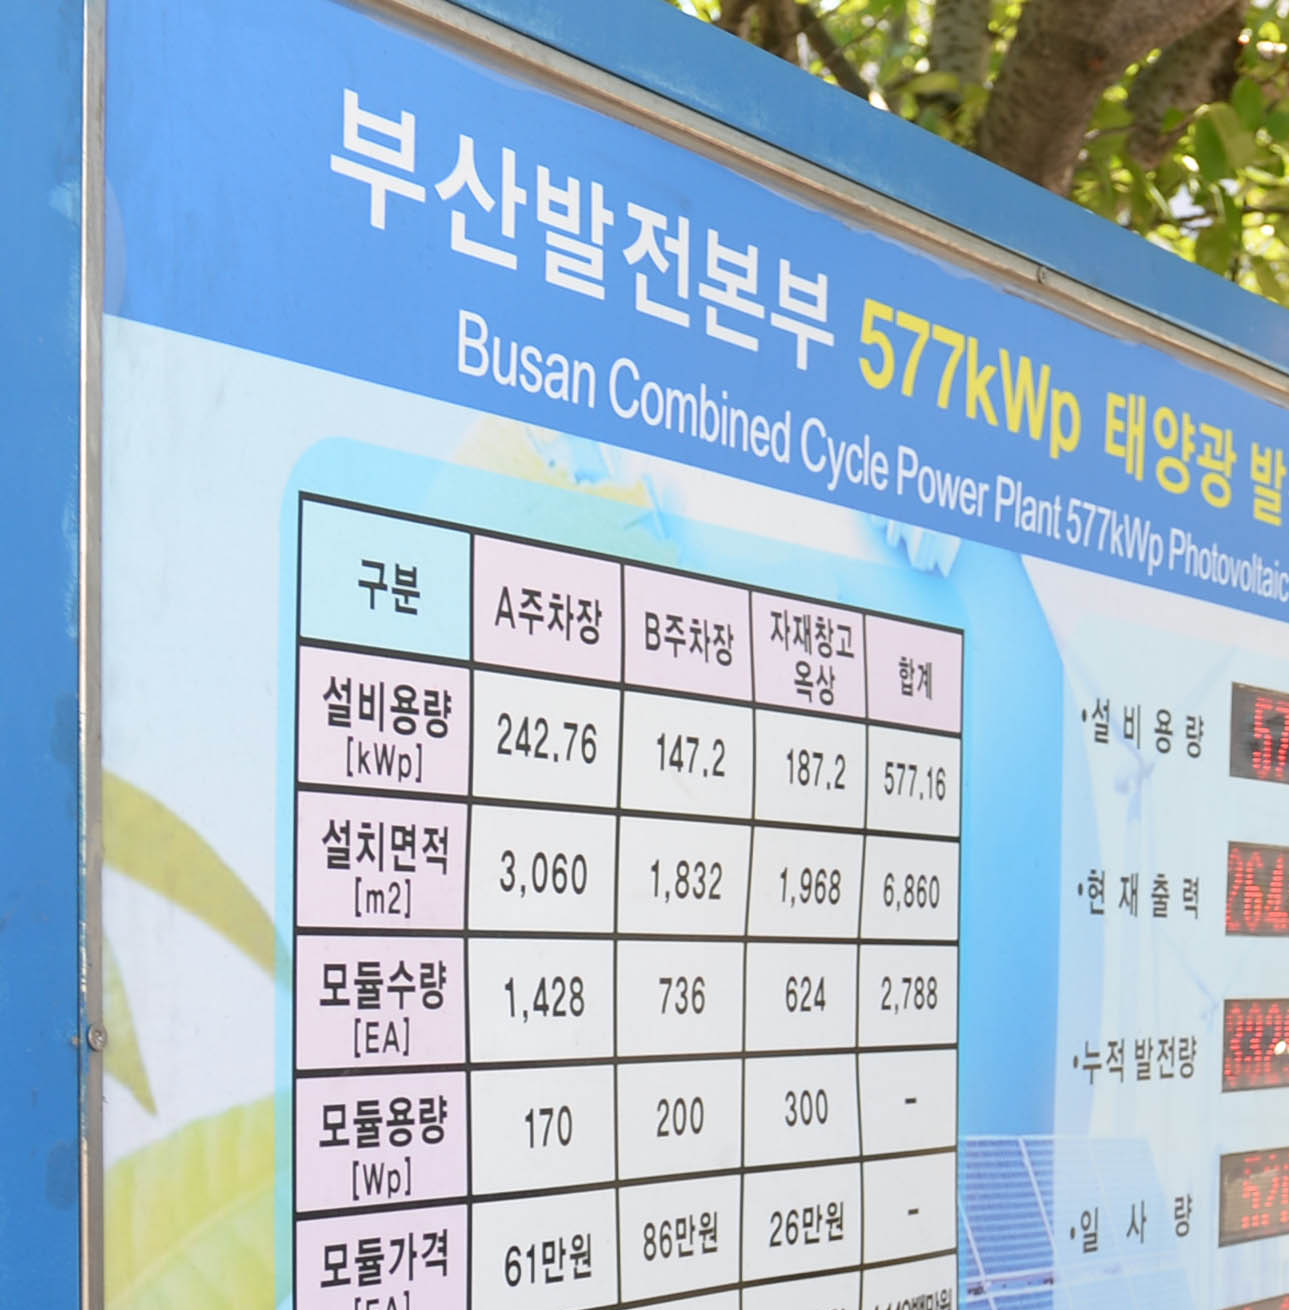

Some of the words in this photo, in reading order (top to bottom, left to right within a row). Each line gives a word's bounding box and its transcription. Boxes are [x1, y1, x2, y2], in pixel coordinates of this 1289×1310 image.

[330, 88, 835, 370] 부산발전본부
[857, 297, 1081, 458] 577kWp
[1104, 393, 1236, 508] 태양광
[458, 309, 596, 409] Busan
[608, 357, 791, 464] Combined
[800, 415, 889, 492] Cycle
[897, 445, 989, 518] Power
[995, 475, 1062, 541] Plant
[1066, 497, 1164, 577] 577kWp
[1169, 525, 1289, 603] Photovoltaic
[358, 559, 420, 616] 구분
[495, 586, 602, 645] A주차장
[645, 611, 734, 666] B주차장
[770, 609, 855, 660] 자재창고
[794, 661, 836, 706] 옥상
[898, 656, 933, 700] 합계
[322, 675, 452, 739] 설비용량
[347, 735, 423, 784] [kWp]
[497, 712, 598, 764] 242.76
[656, 732, 726, 778] 147.2
[787, 747, 846, 790] 187.2
[884, 761, 946, 801] 577.16
[321, 819, 449, 875] 설치면적
[354, 876, 412, 919] [m2]
[500, 850, 588, 898] 3,060
[650, 859, 723, 903] 1,832
[780, 866, 842, 908] 1,968
[883, 872, 941, 912] 6,860
[319, 959, 447, 1011] 모듈수량
[504, 975, 585, 1023] 1,428
[659, 976, 706, 1015] 736
[785, 976, 827, 1013] 624
[881, 976, 938, 1015] 2,788
[353, 1016, 410, 1059] [EA]
[319, 1095, 448, 1149] 모듈용량
[524, 1105, 573, 1149] 170
[656, 1096, 704, 1138] 200
[785, 1088, 828, 1128] 300
[352, 1156, 412, 1201] [Wp]
[643, 1211, 718, 1262] 86만원
[769, 1201, 844, 1248] 26만원
[320, 1228, 448, 1289] 모듈가격
[504, 1232, 592, 1287] 61만원
